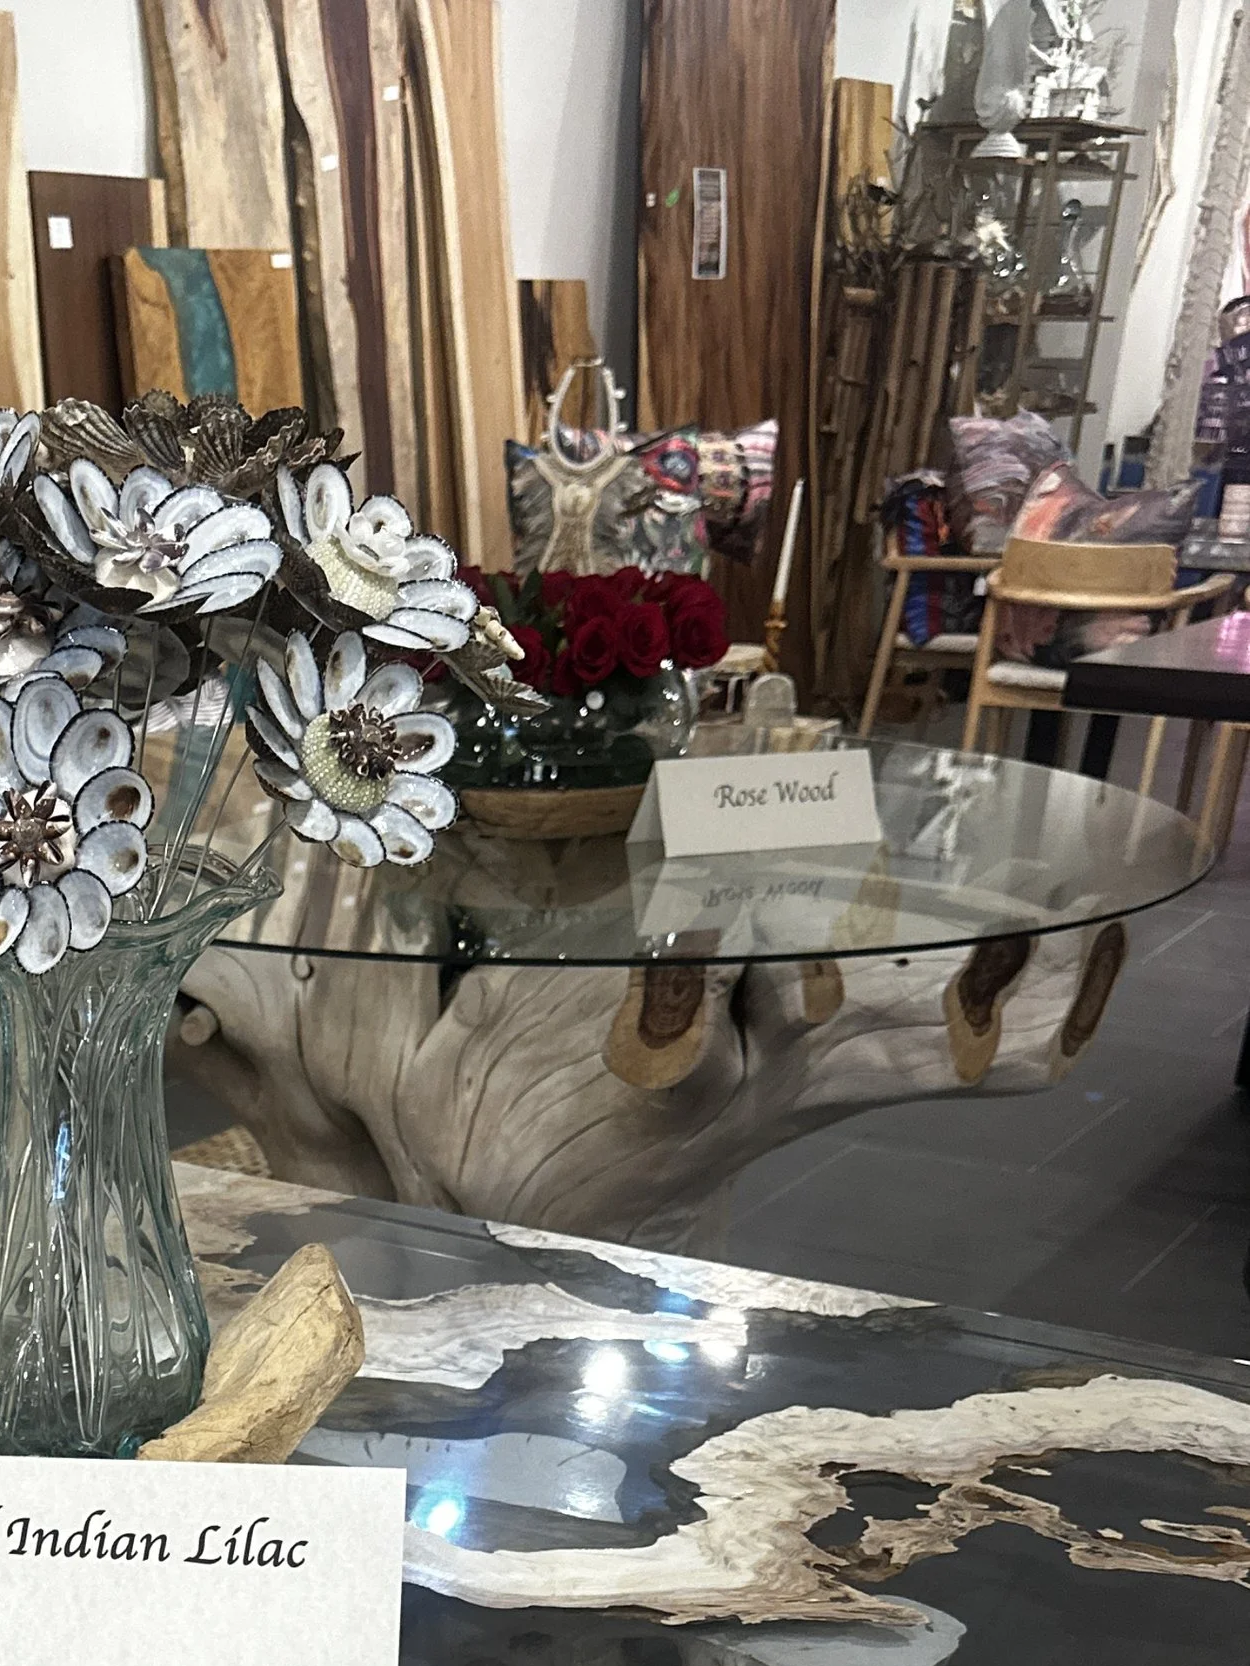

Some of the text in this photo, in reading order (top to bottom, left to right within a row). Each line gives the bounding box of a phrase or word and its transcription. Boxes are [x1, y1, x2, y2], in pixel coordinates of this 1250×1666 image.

[713, 771, 840, 809] Rose Wood
[6, 1509, 171, 1562] Indian
[183, 1516, 309, 1568] Lilac
